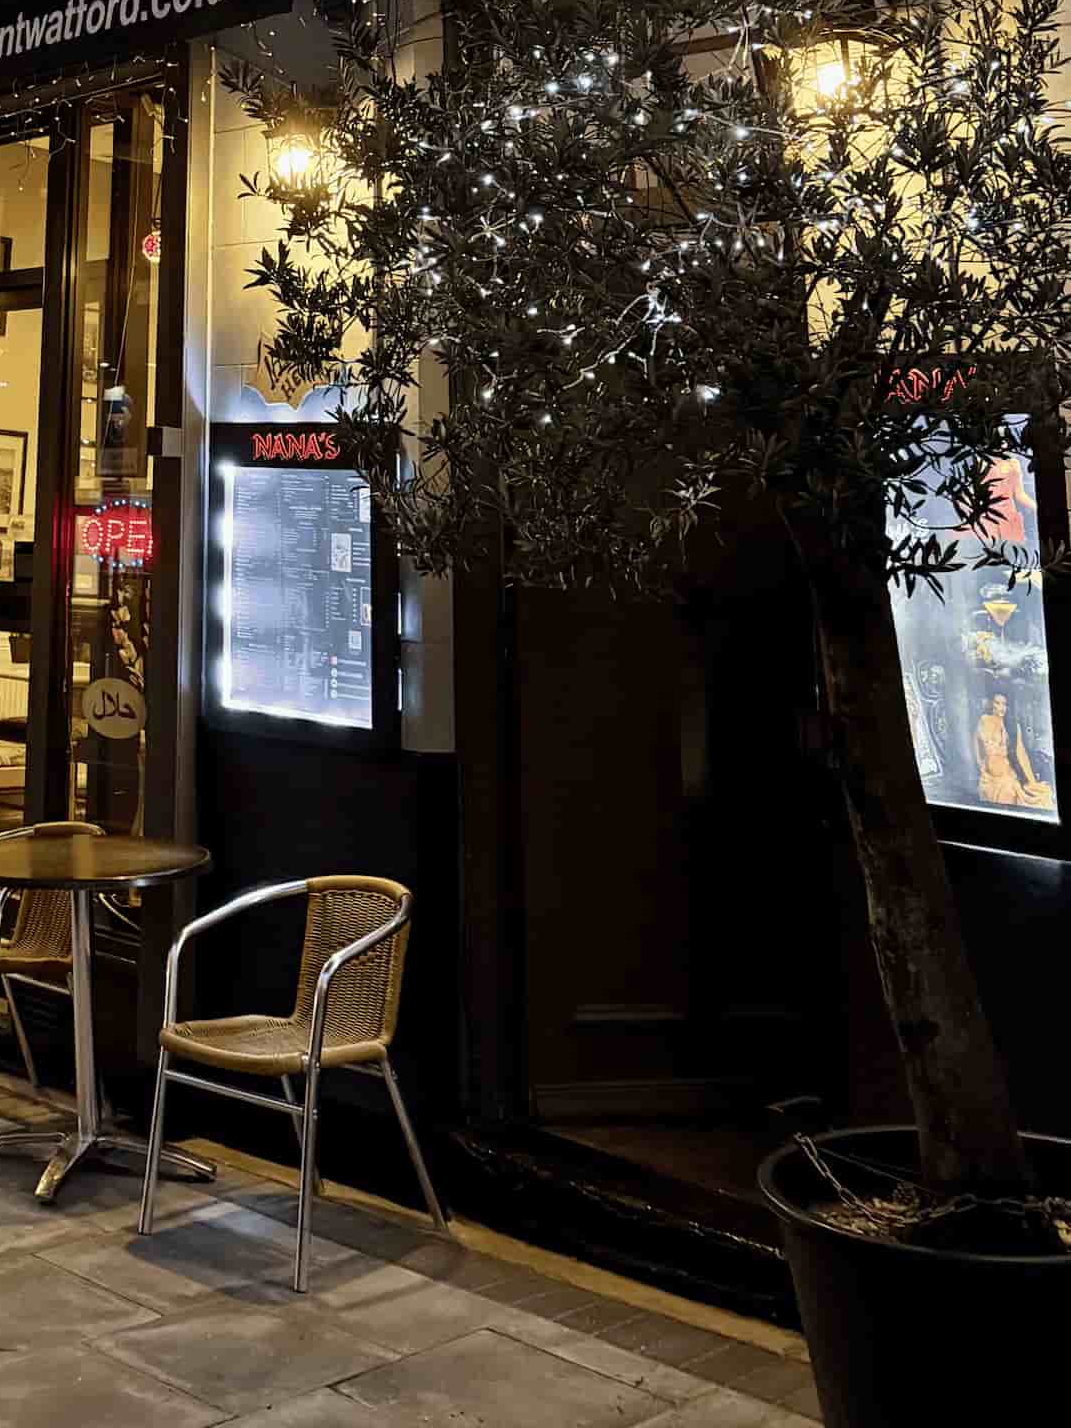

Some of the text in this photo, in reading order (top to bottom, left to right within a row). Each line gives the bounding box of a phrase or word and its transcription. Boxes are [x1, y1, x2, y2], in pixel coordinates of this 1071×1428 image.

[251, 432, 341, 460] NANA'S
[81, 518, 154, 555] OPE
[92, 689, 138, 720] حلال
